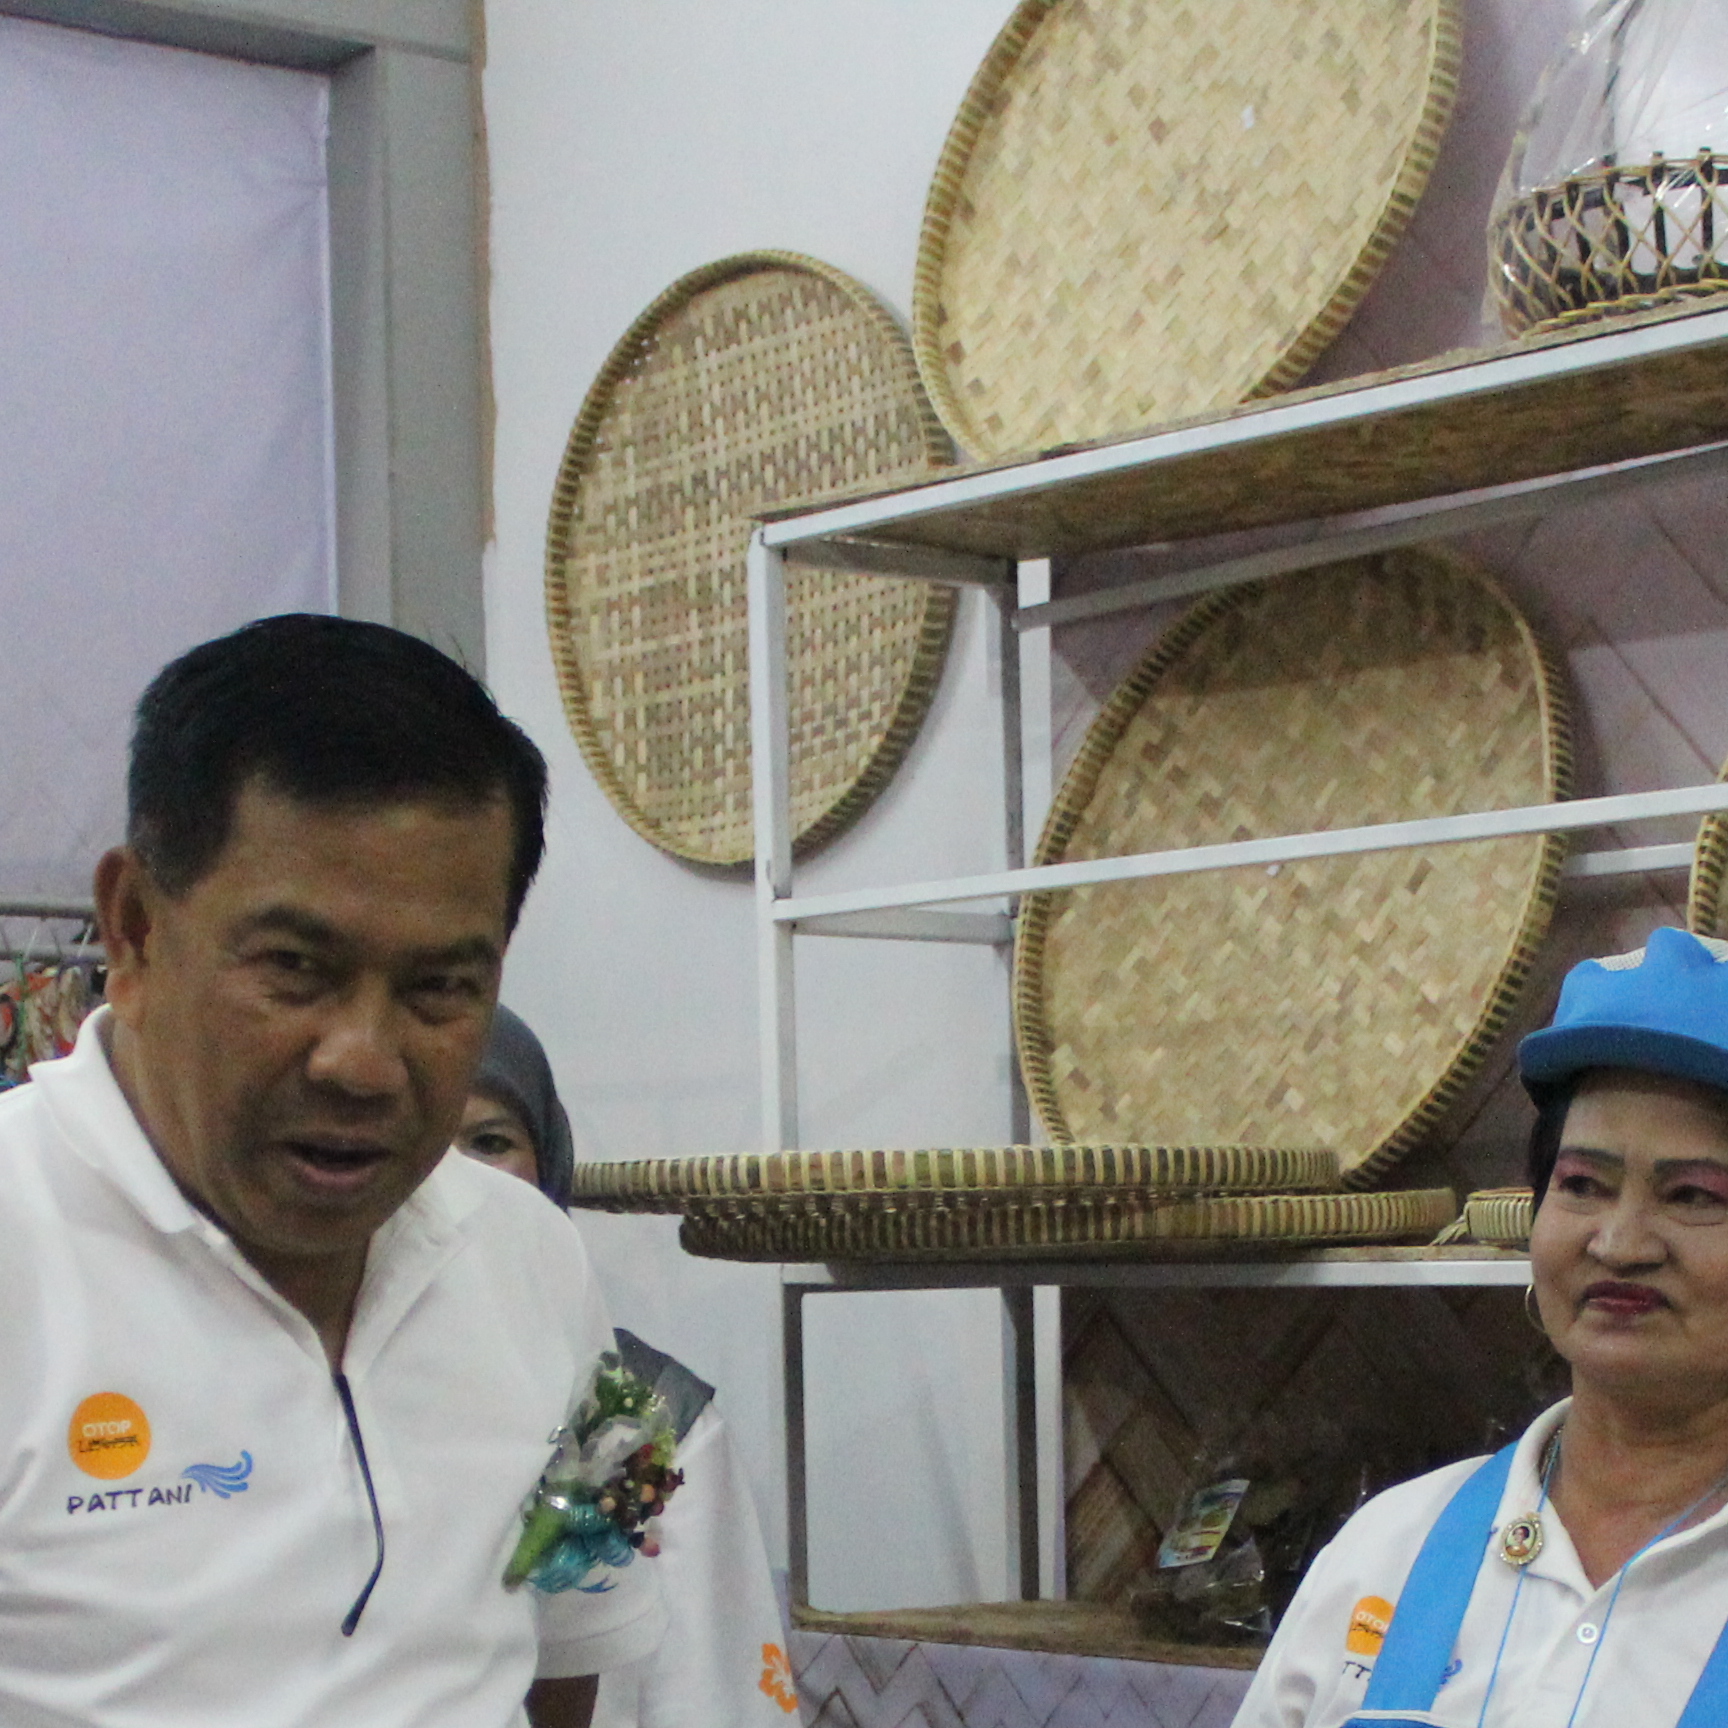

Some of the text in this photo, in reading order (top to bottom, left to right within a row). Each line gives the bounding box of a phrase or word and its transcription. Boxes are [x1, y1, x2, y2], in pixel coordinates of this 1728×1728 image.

[82, 1420, 132, 1437] OTOP
[66, 1483, 192, 1516] PATTANI
[1355, 1610, 1390, 1633] OTO
